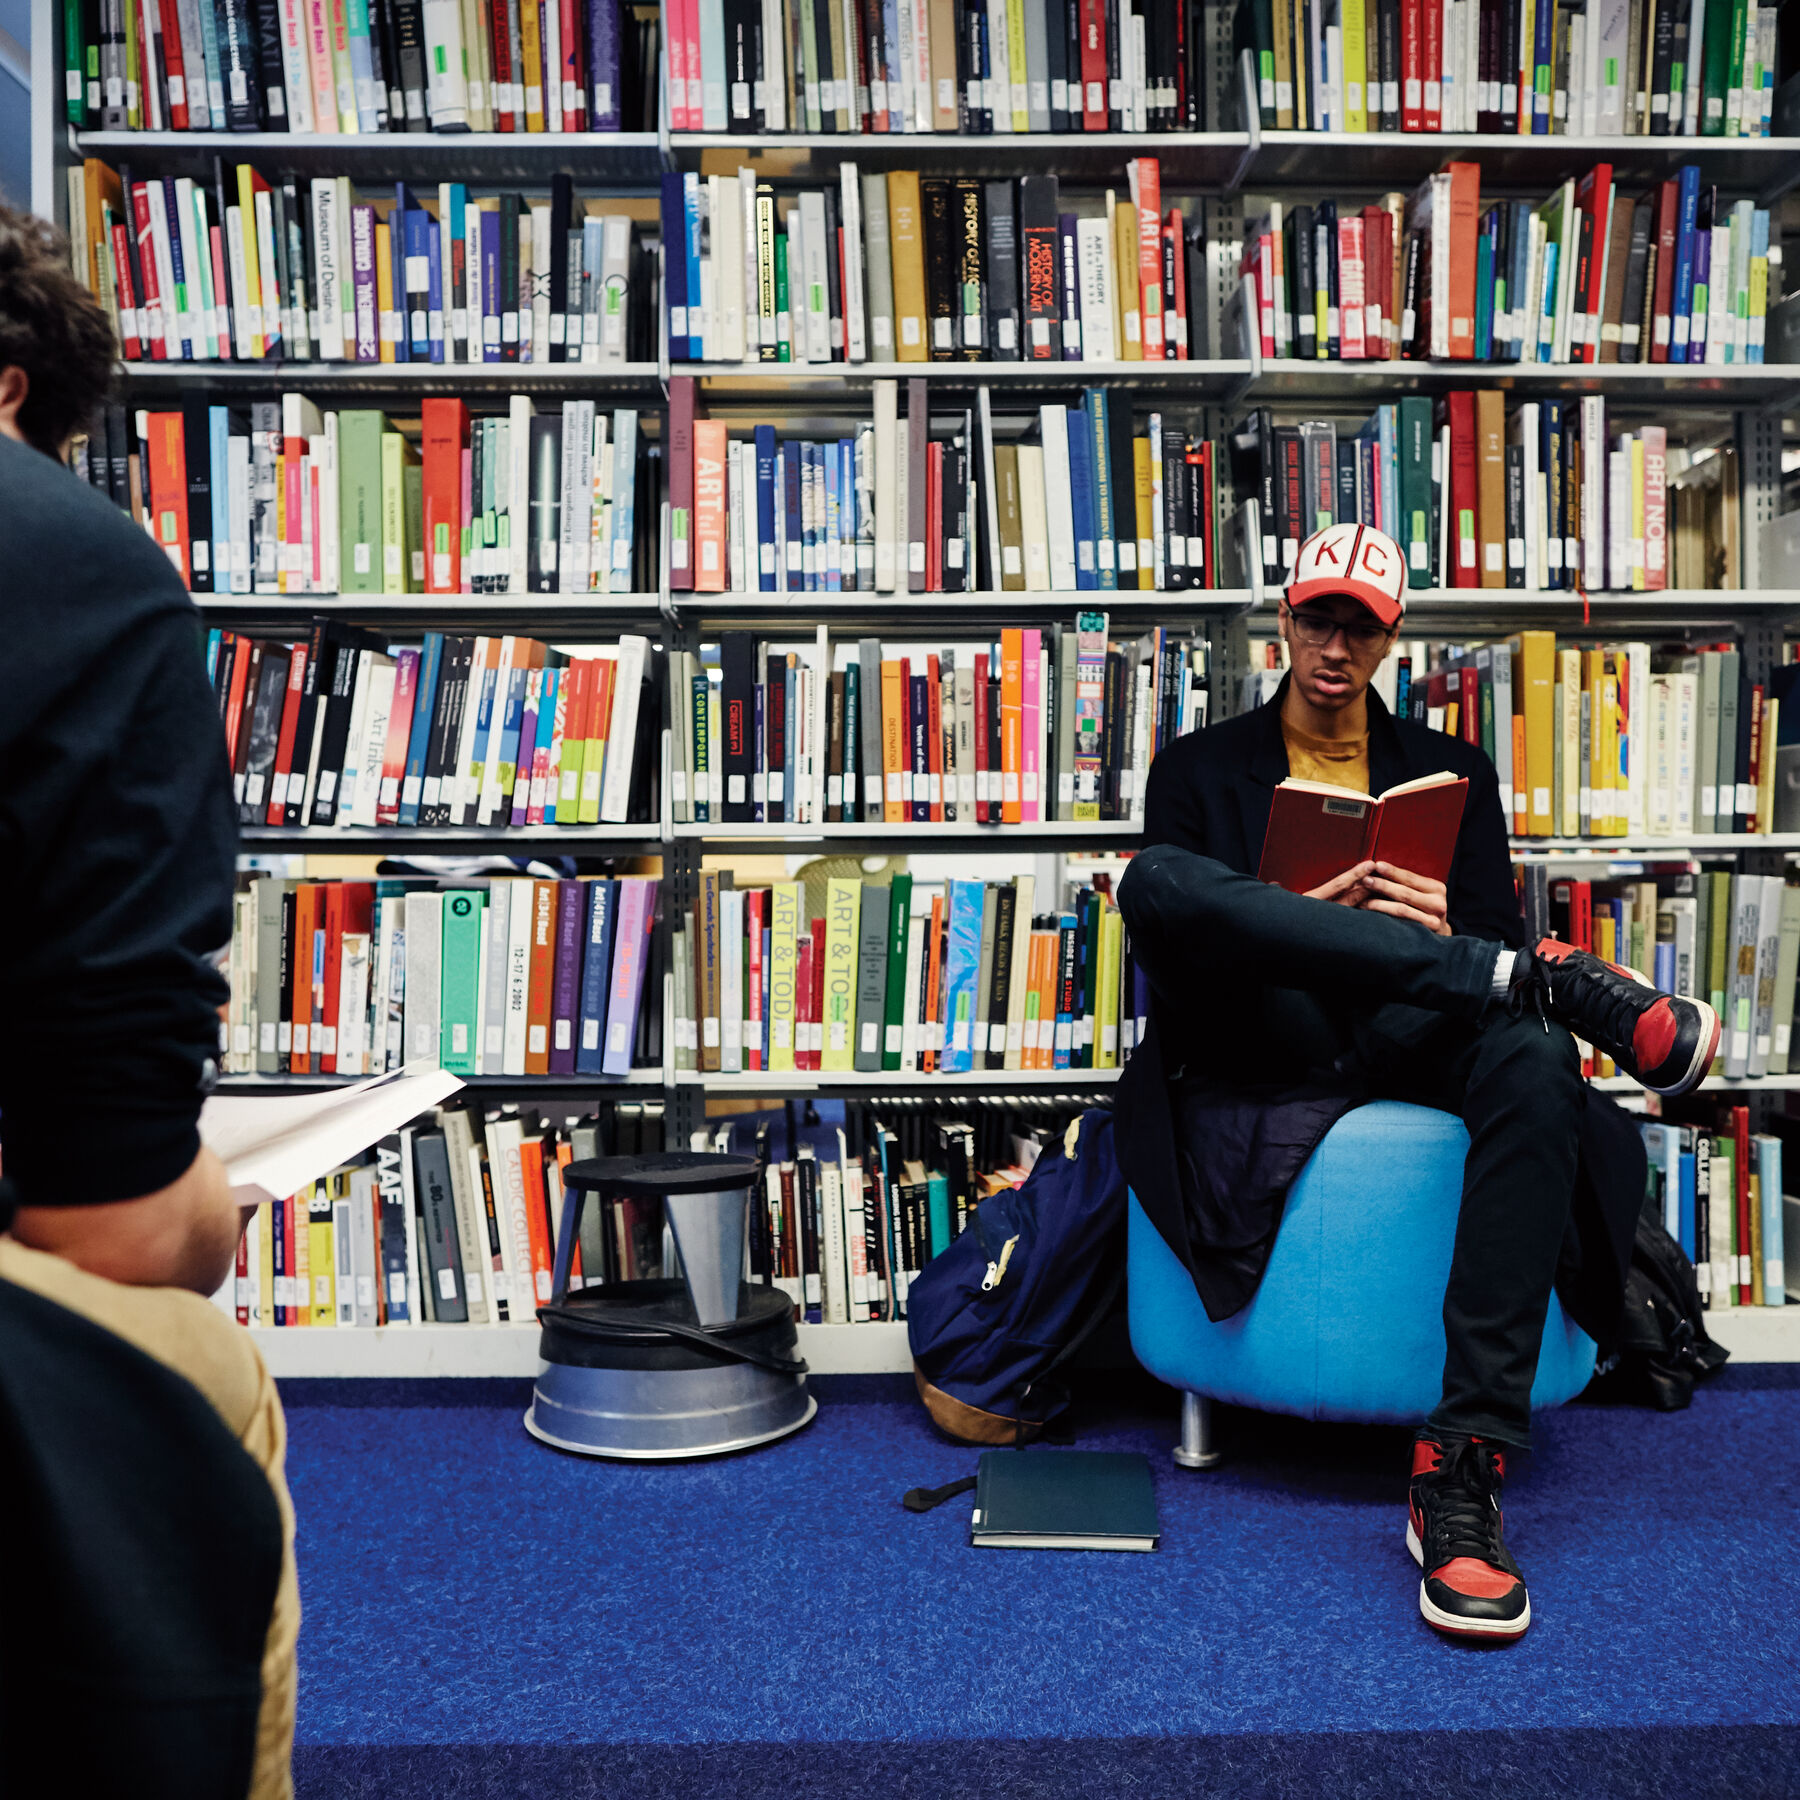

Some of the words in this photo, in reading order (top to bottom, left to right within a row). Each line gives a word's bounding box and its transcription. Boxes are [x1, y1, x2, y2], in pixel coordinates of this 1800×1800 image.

[317, 189, 332, 252] Museum
[353, 207, 371, 272] CATALOGUE
[1140, 208, 1160, 250] ART
[321, 255, 334, 270] of
[1028, 238, 1042, 292] MODERN
[1040, 243, 1053, 287] HISTORY
[1030, 293, 1043, 312] ART
[1043, 290, 1054, 307] OF
[581, 409, 590, 442] motion
[1093, 393, 1103, 418] FROM
[1099, 484, 1108, 496] TO
[580, 454, 588, 486] archive
[698, 458, 722, 512] ART
[1646, 454, 1665, 500] ART
[1646, 503, 1666, 552] NO
[1315, 536, 1346, 566] K
[1362, 542, 1388, 577] C
[1164, 677, 1172, 696] ARTS
[373, 710, 388, 737] Art
[696, 693, 706, 772] CONTEMPORAR
[729, 705, 738, 741] CREAM
[888, 717, 896, 768] DESTINATION
[595, 885, 607, 900] Art
[705, 891, 715, 923] Grands
[591, 918, 604, 944] Basel
[775, 893, 794, 941] ART
[833, 889, 854, 937] ART
[704, 924, 714, 968] Spectacles
[774, 946, 793, 961] &
[831, 944, 851, 959] &
[1065, 930, 1075, 960] INSIDE
[1065, 961, 1074, 978] THE
[1064, 980, 1073, 1012] STUDIO
[377, 1147, 403, 1205] AAF
[506, 1148, 523, 1206] CALDIC
[1697, 1138, 1709, 1196] COLLAGE
[891, 1184, 901, 1216] LOOKING
[918, 1200, 926, 1215] Late
[956, 1195, 967, 1209] art
[513, 1207, 531, 1275] COLLECT
[893, 1216, 902, 1231] FOR
[894, 1231, 904, 1272] MUSHROO
